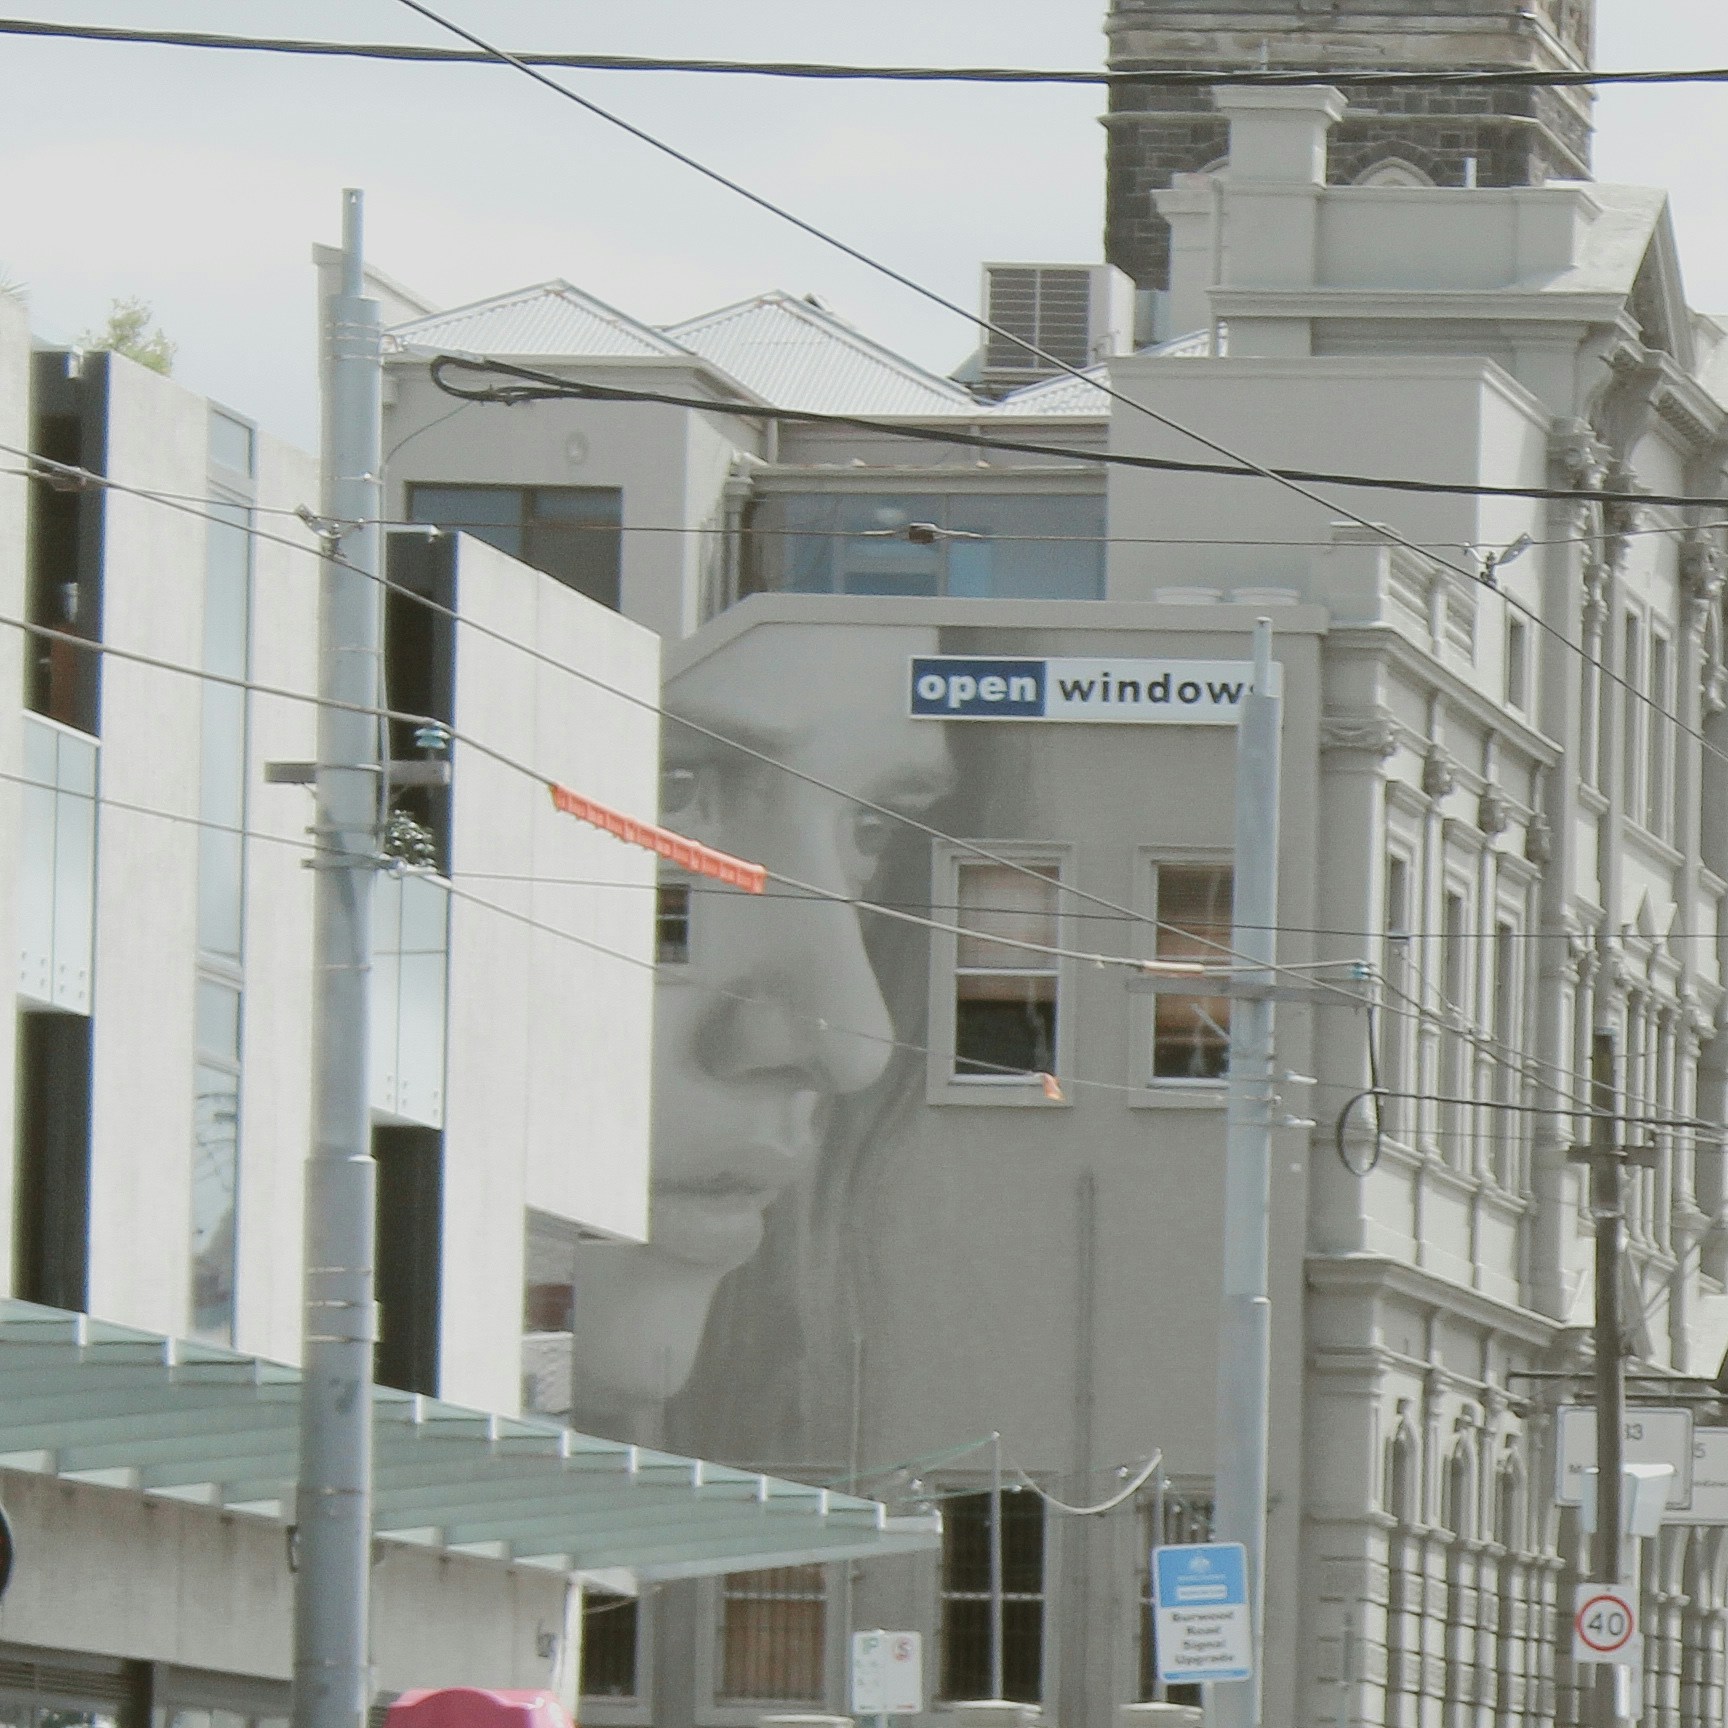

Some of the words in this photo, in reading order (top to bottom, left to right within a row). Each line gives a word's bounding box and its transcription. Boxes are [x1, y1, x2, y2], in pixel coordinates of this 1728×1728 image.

[917, 672, 1037, 709] open
[1058, 672, 1255, 704] window
[1587, 1612, 1625, 1636] 40
